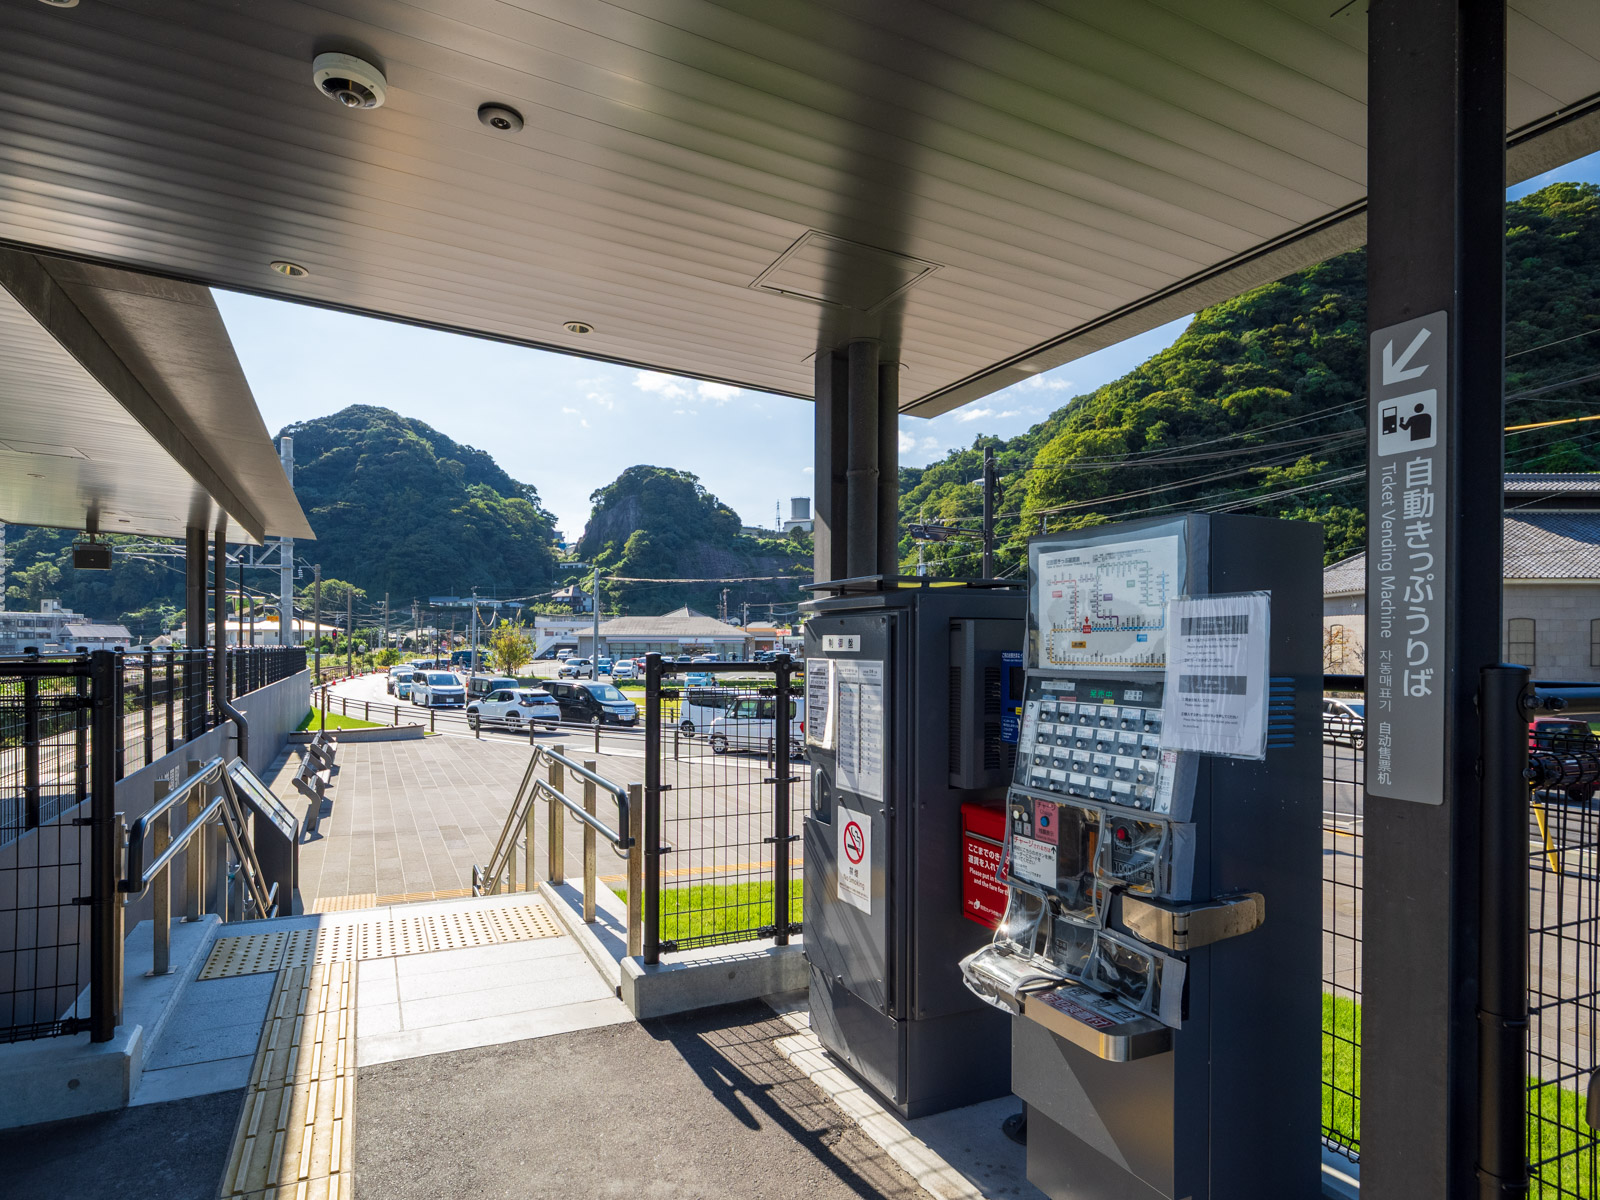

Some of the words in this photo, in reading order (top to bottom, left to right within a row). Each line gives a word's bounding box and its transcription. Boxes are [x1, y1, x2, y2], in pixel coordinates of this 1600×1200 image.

[1381, 462, 1396, 507] Ticket
[1378, 509, 1396, 571] Vending
[1381, 576, 1396, 638] Machine
[1403, 456, 1434, 698] 自動きっぷうりば
[1379, 650, 1393, 712] 자동매표기
[1377, 722, 1392, 786] 自动售票机
[969, 867, 982, 878] Please
[973, 878, 981, 886] and
